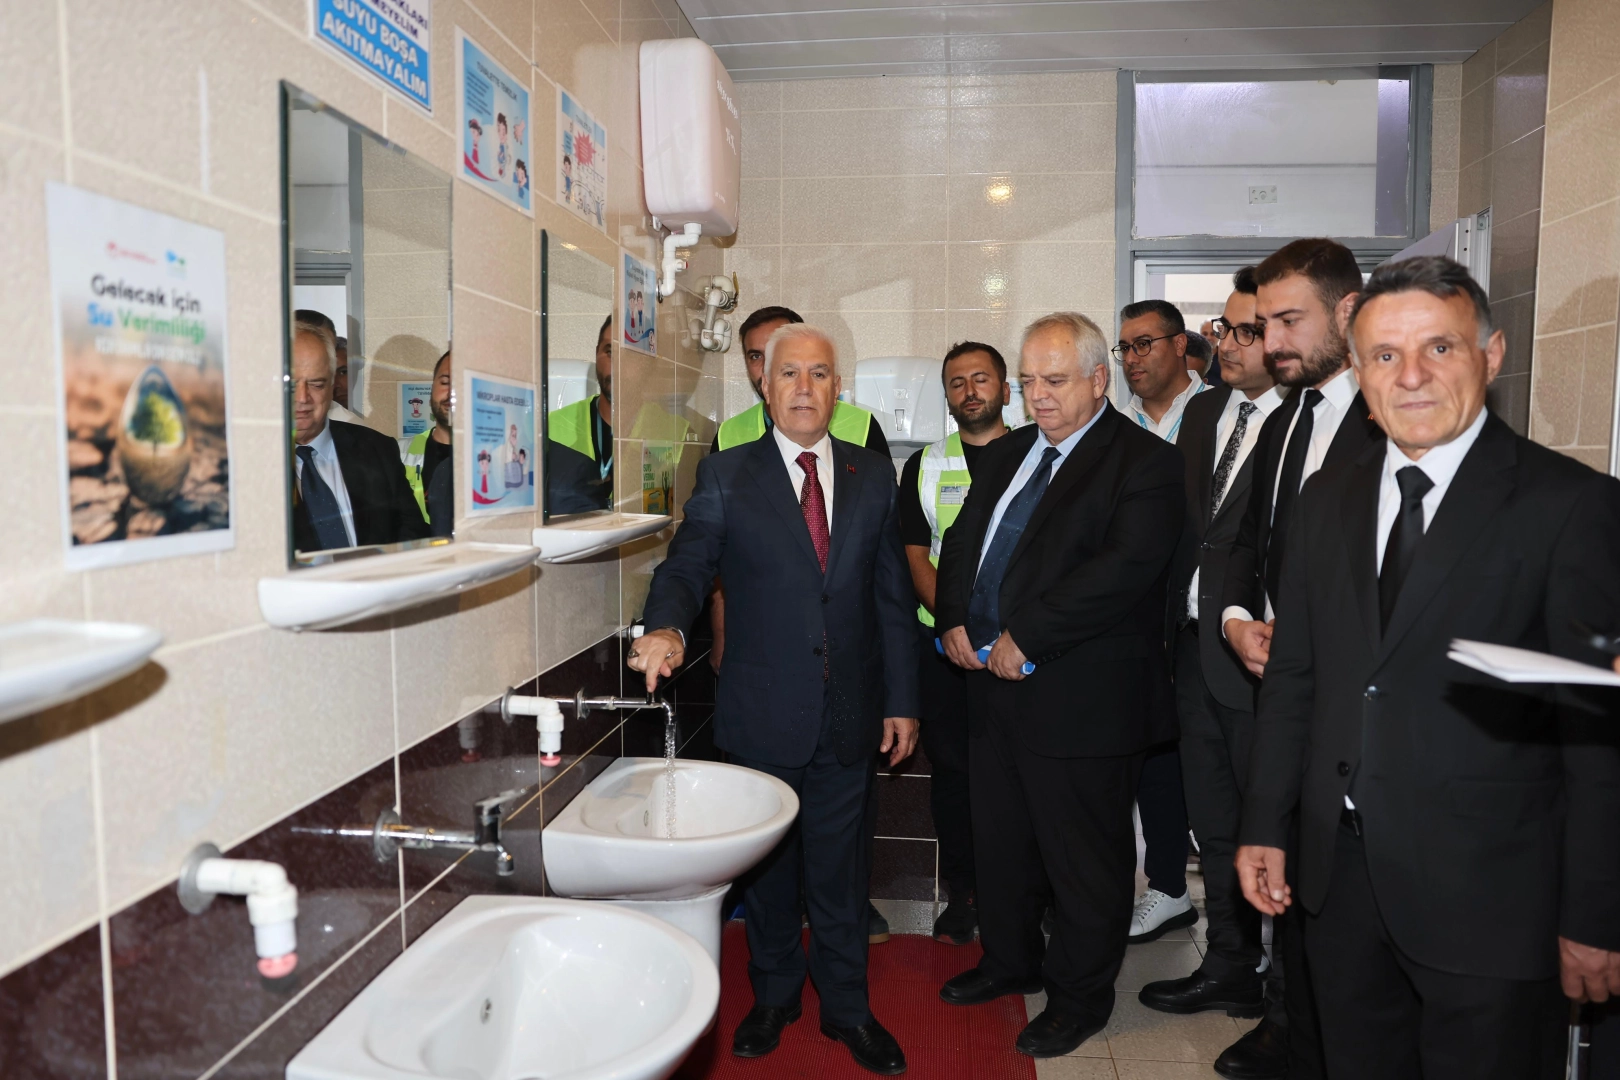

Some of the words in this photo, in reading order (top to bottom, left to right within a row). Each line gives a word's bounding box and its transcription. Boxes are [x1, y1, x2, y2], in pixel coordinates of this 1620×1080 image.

[322, 11, 427, 99] AKITMAYALIM
[380, 23, 419, 68] BOŞA
[87, 301, 114, 326] Su
[91, 274, 167, 307] Gelecek
[172, 288, 201, 315] için
